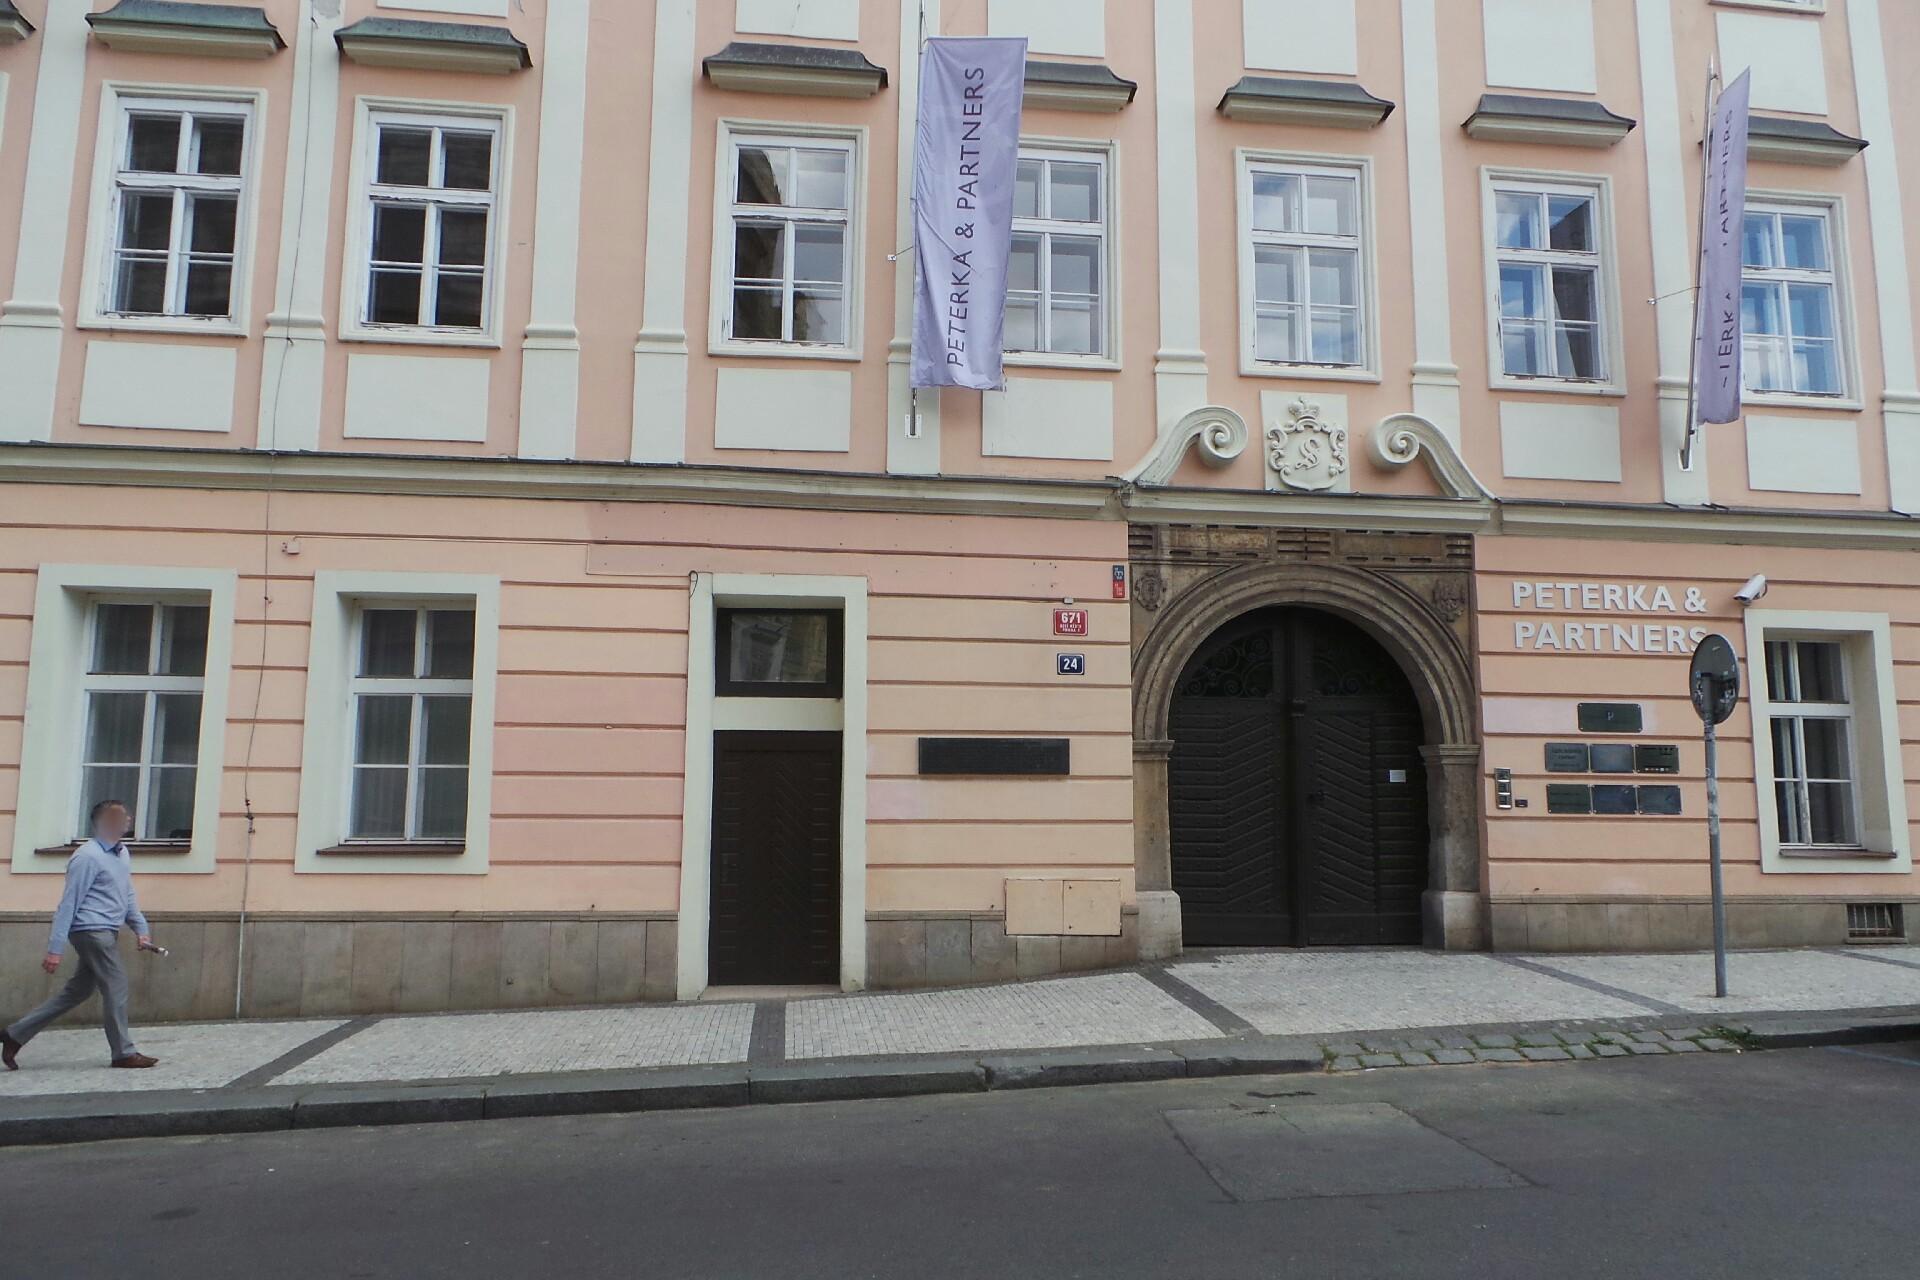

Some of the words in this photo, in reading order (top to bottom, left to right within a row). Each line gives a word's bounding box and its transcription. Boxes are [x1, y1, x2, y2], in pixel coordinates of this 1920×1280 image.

[956, 67, 984, 210] PARTNERS
[955, 223, 975, 239] &
[947, 250, 973, 367] PETERKA
[1512, 581, 1677, 612] PETERKA
[1683, 586, 1707, 613] &
[1061, 612, 1081, 624] 671
[1514, 621, 1708, 653] PARTNERS
[1063, 658, 1078, 670] 24
